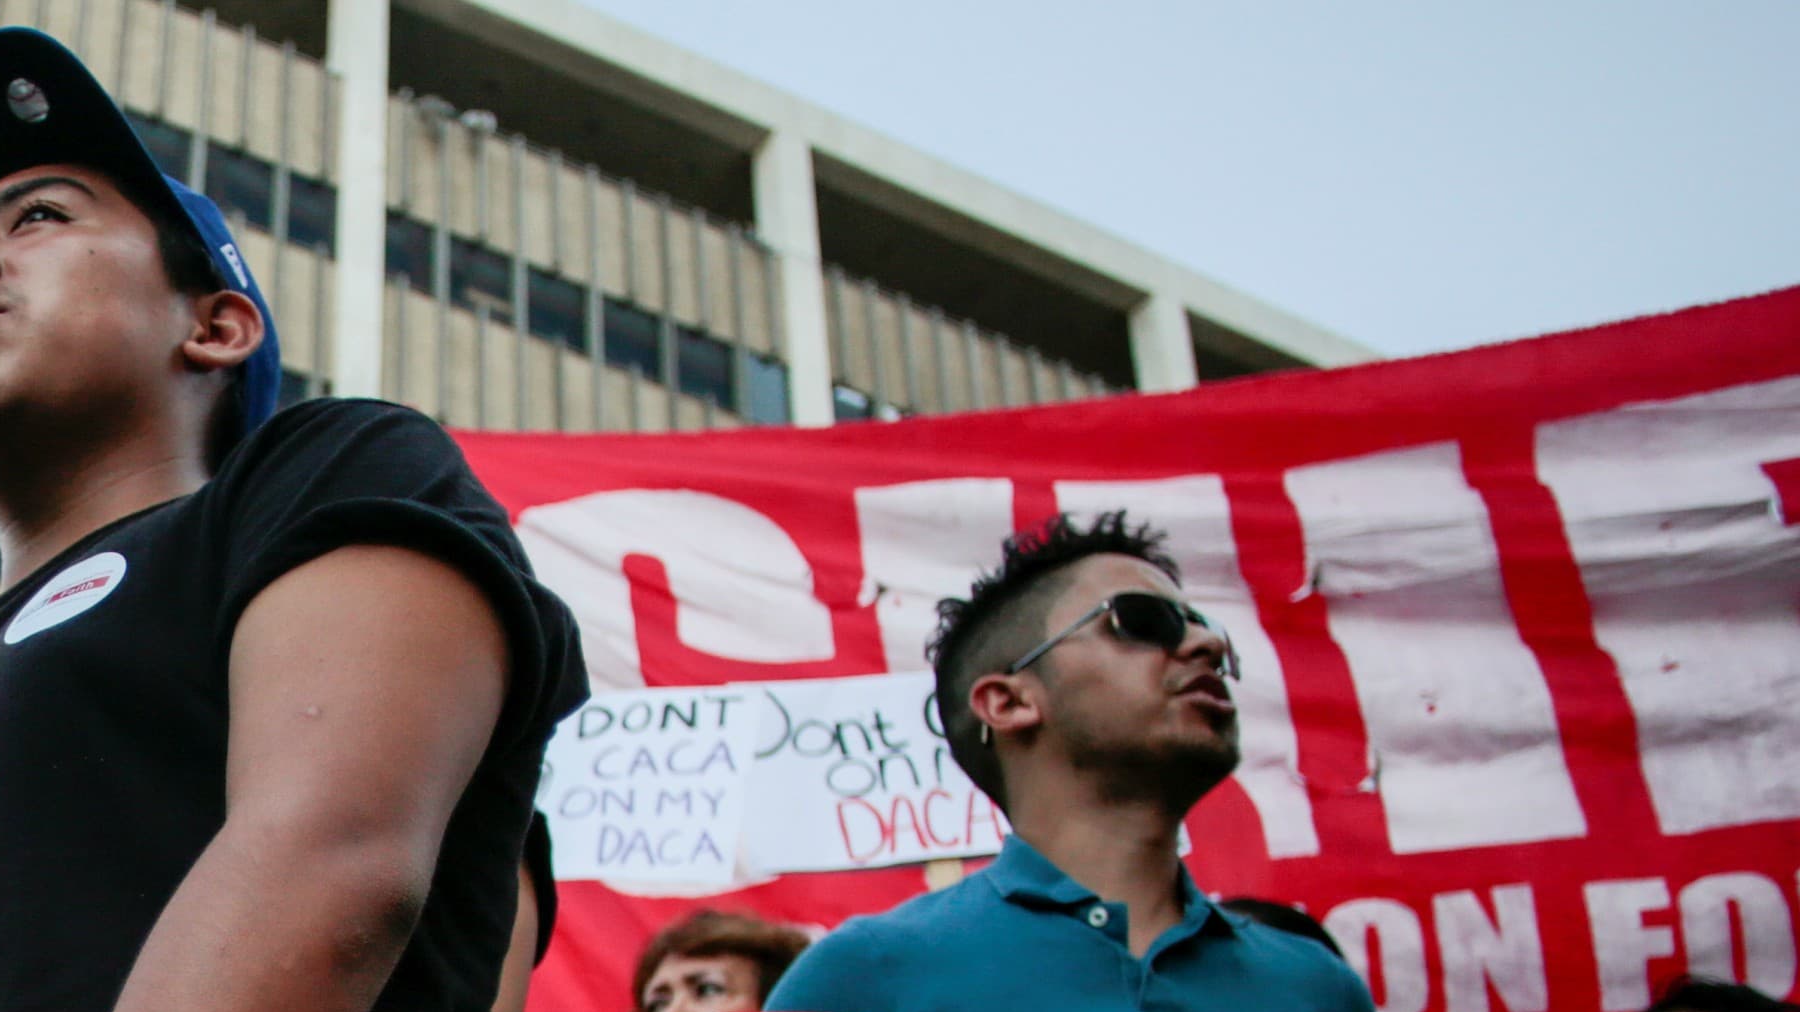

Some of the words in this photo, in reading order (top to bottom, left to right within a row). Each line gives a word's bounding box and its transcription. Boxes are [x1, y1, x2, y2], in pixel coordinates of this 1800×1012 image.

[578, 693, 744, 740] DONT
[593, 738, 737, 782] CACA
[559, 786, 635, 820] ON
[655, 786, 726, 818] MY
[835, 786, 1004, 864] DACA
[598, 824, 725, 867] DACA
